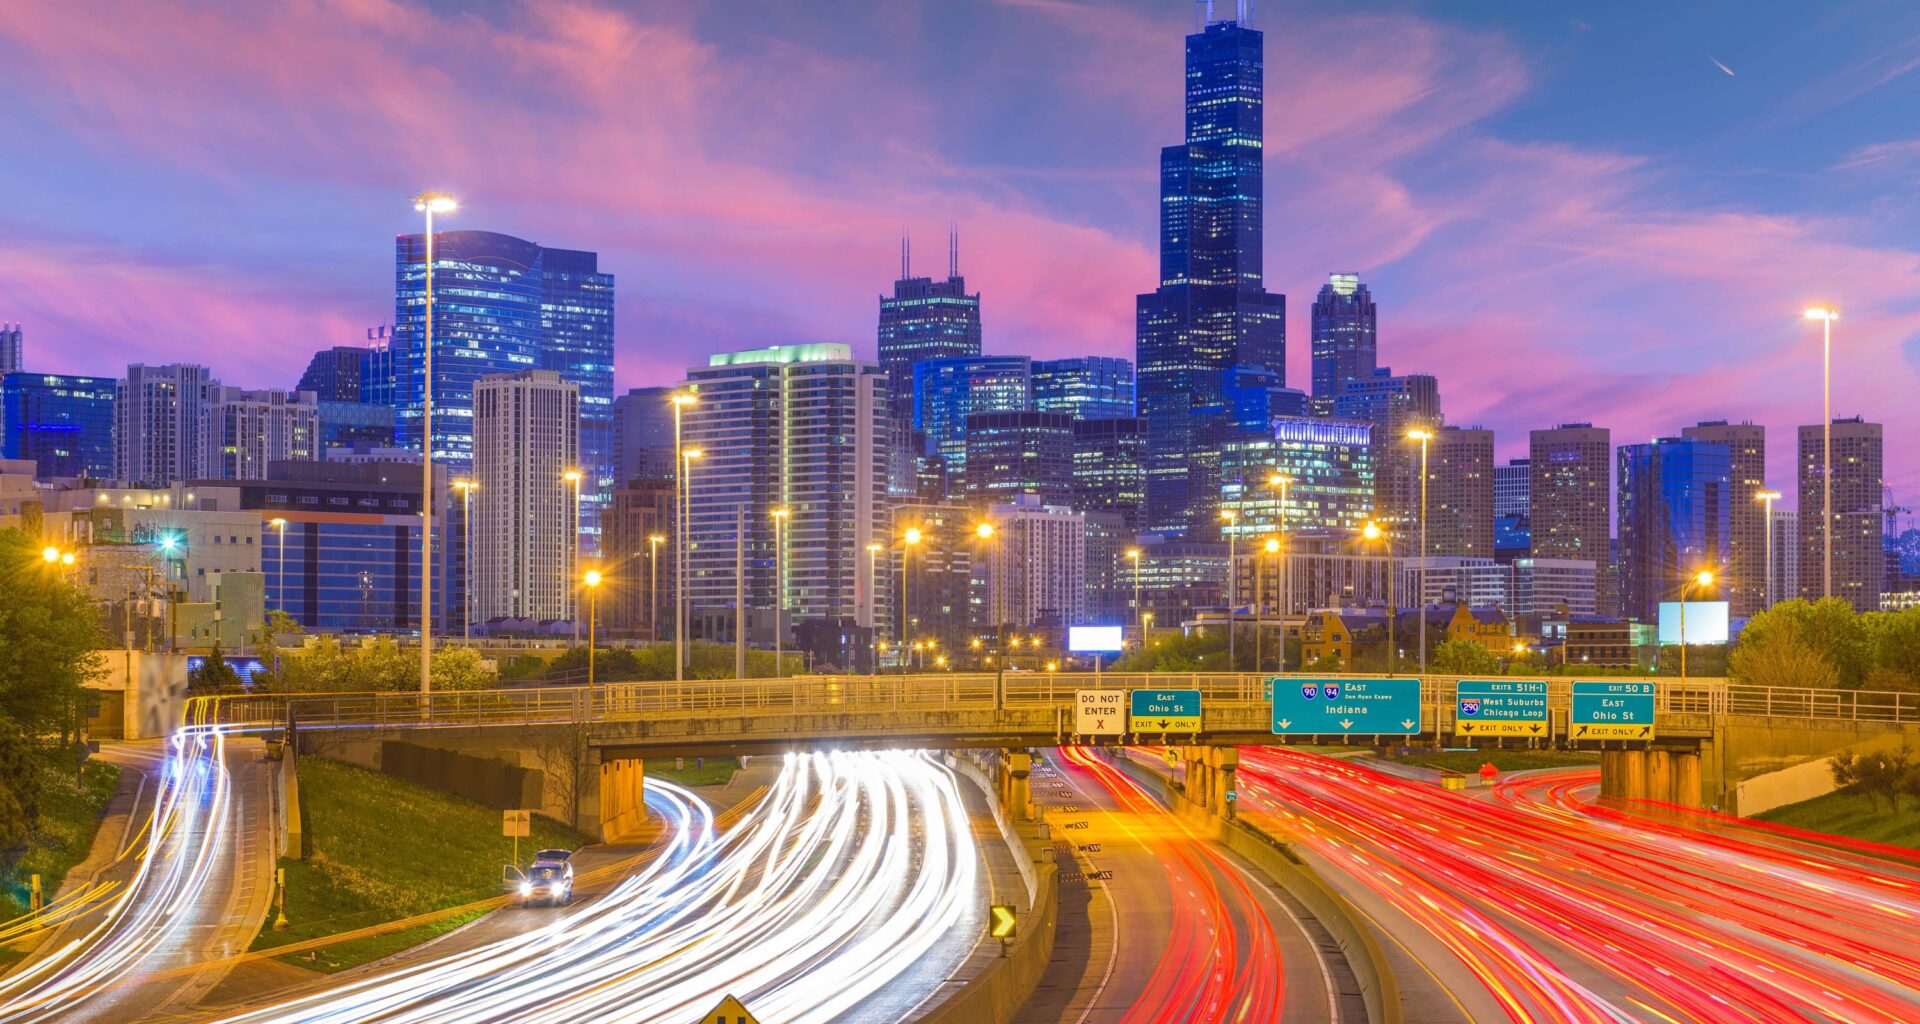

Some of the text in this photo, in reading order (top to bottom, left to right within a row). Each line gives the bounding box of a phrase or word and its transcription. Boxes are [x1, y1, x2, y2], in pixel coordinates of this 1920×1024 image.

[1304, 684, 1367, 696] 90 94 EAST
[1082, 695, 1120, 703] DO NOT
[1602, 699, 1624, 707] EAST
[1326, 705, 1368, 714] Indiana
[1463, 703, 1478, 711] 290
[1484, 709, 1519, 717] Chicago
[1593, 711, 1634, 720] Ohio St
[1097, 720, 1104, 729] X
